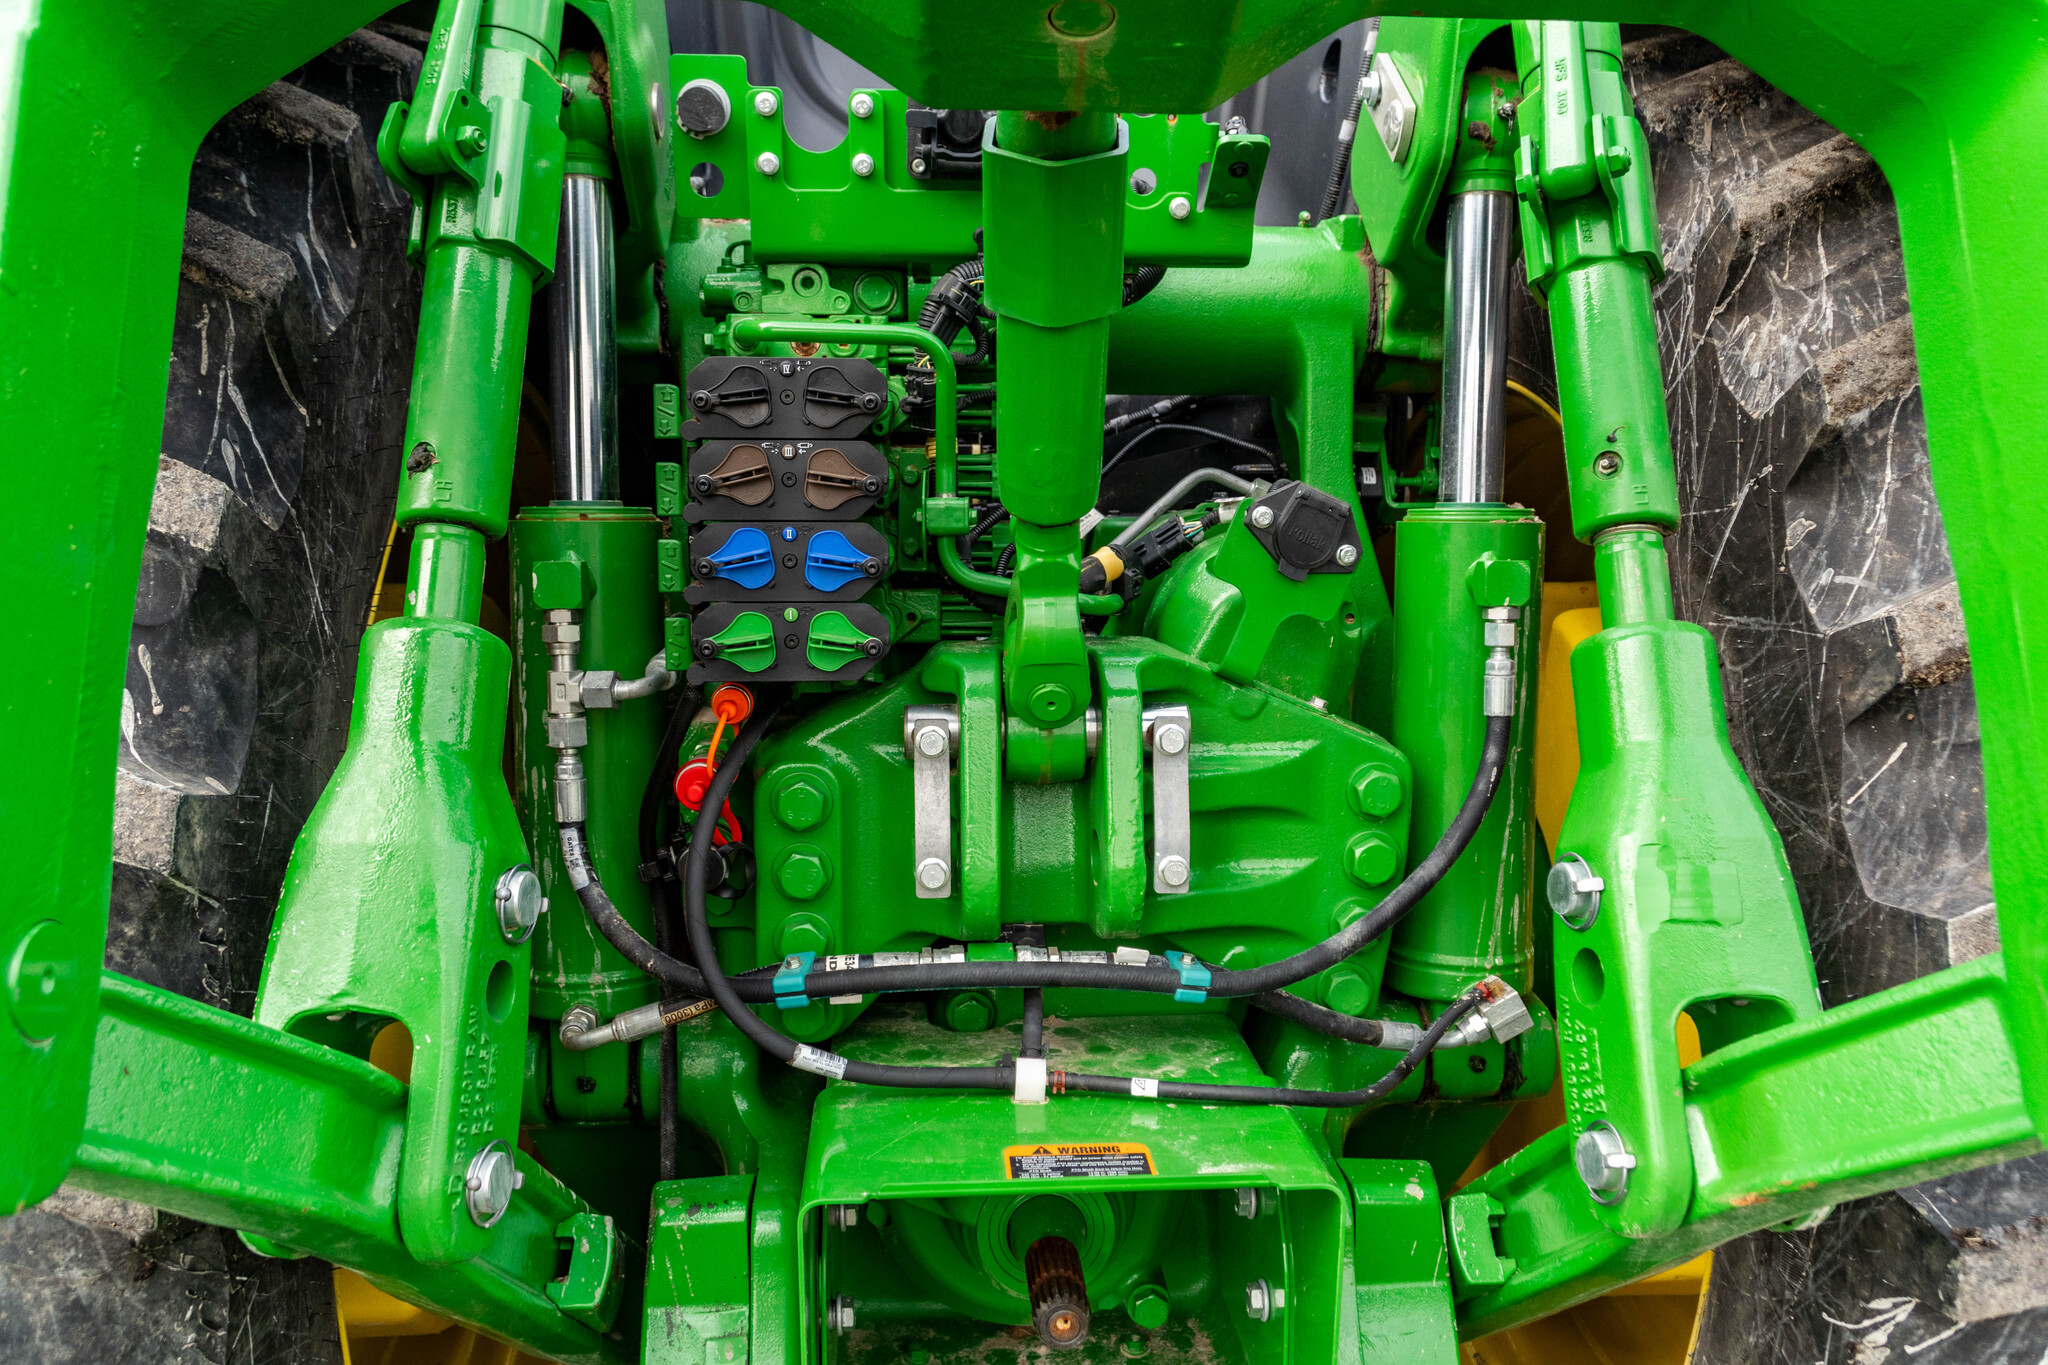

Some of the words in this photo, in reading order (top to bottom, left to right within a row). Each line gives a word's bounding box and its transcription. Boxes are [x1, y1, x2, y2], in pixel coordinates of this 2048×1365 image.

[783, 364, 790, 373] IV
[784, 447, 793, 457] III
[434, 480, 453, 502] LH
[786, 529, 793, 539] II
[1288, 523, 1327, 549] Pollak
[567, 836, 575, 857] GATES
[1057, 1146, 1120, 1154] WARNING
